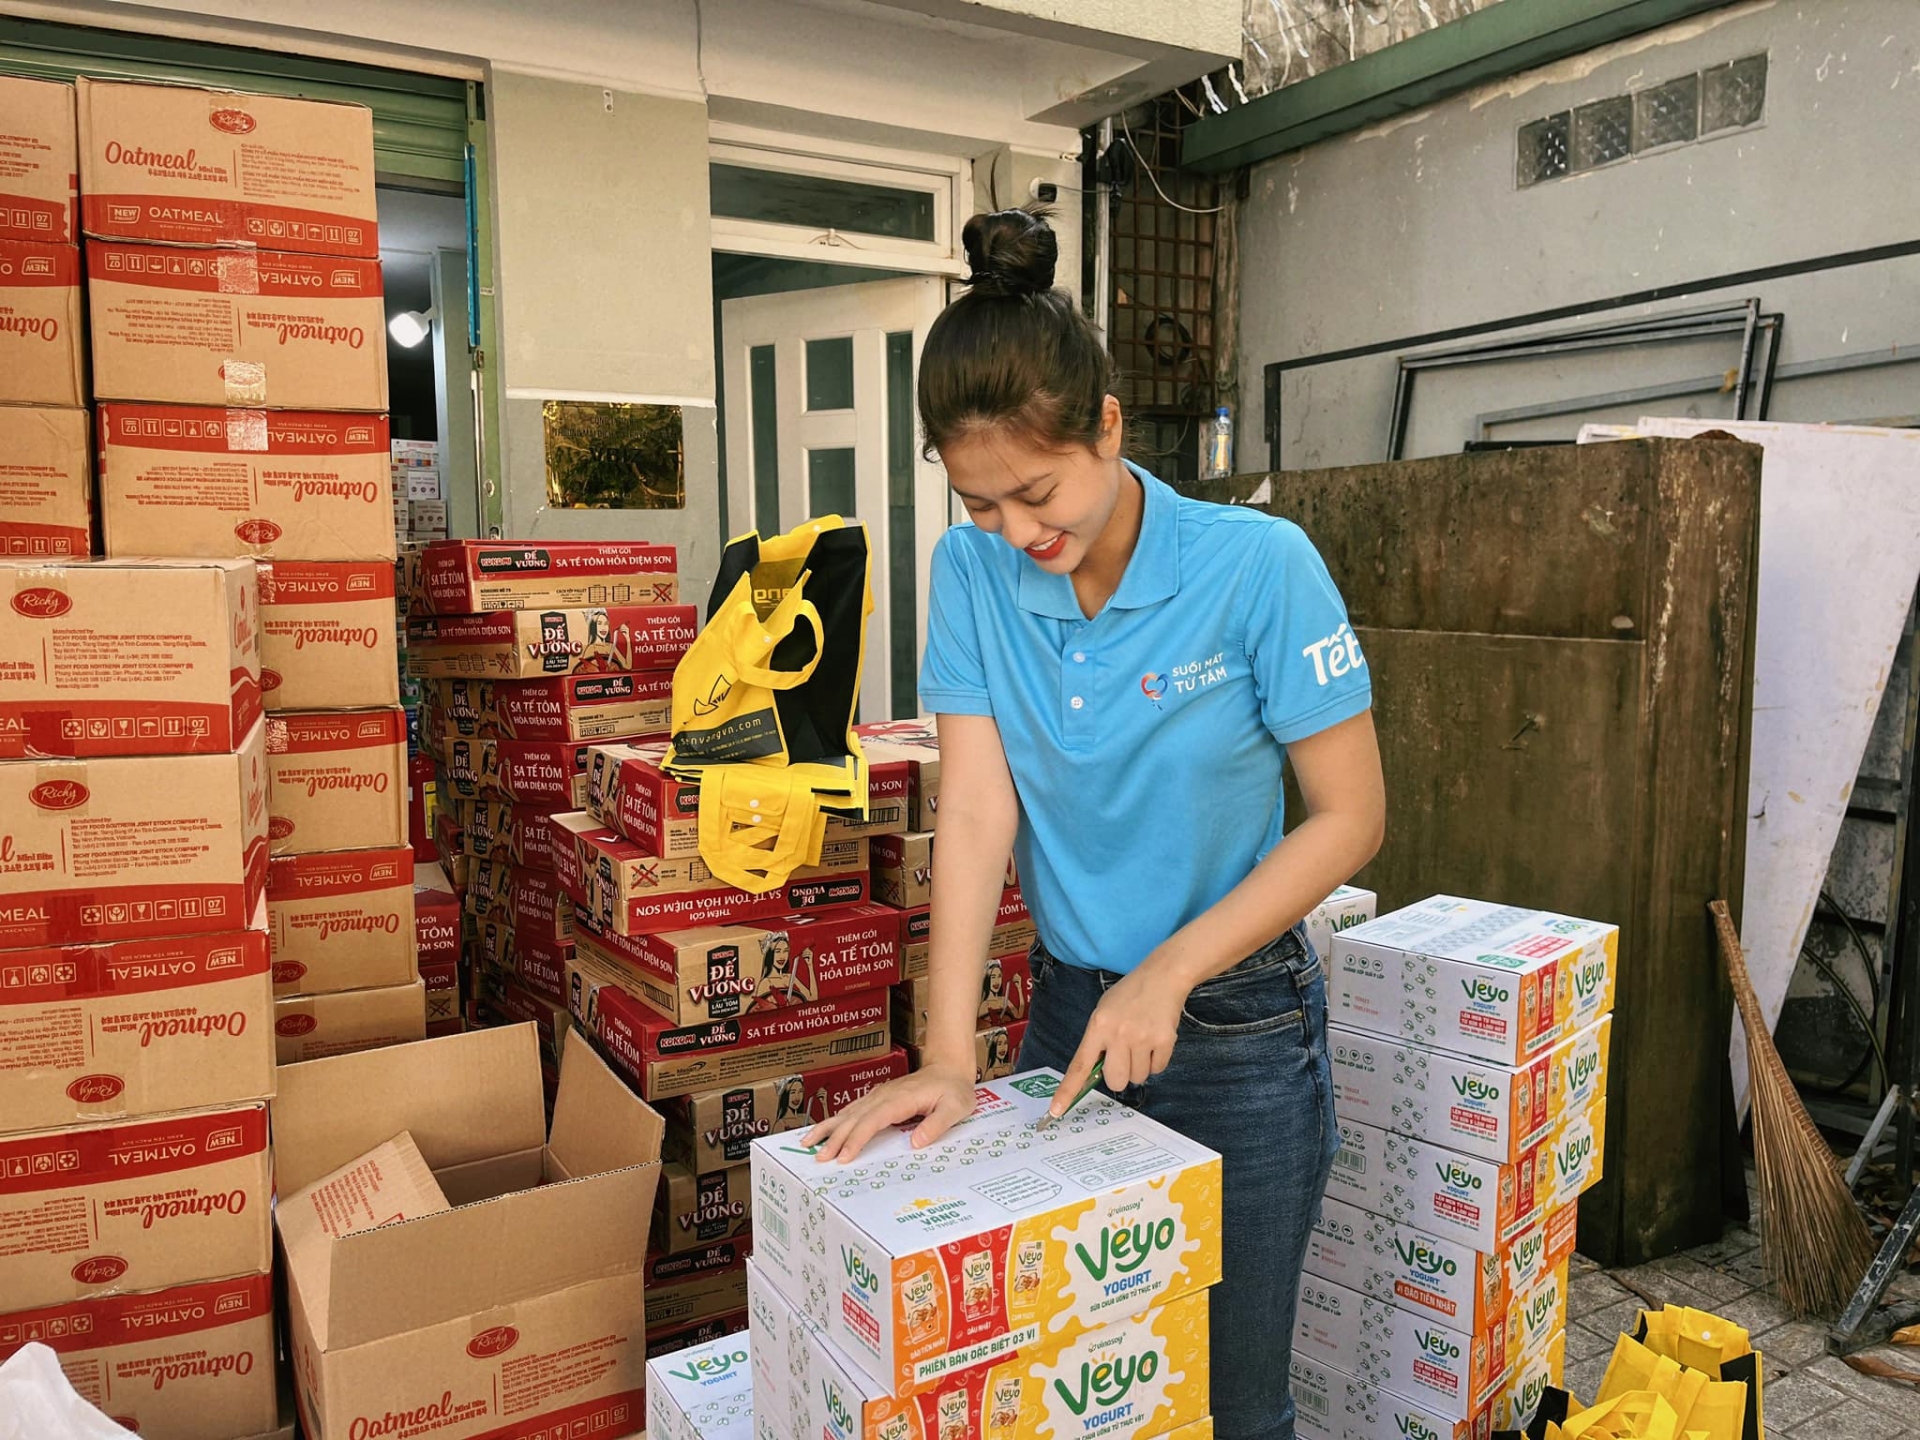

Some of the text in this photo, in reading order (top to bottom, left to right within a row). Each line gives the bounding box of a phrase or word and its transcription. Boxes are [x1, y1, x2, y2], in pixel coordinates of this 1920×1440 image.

[105, 141, 197, 171] Oatmeal
[36, 214, 48, 222] 07
[114, 208, 137, 217] NEW
[149, 206, 224, 224] OATMEAL
[26, 263, 49, 272] NEW
[334, 276, 355, 284] NEW
[277, 323, 364, 349] Oatmeal
[353, 433, 370, 441] NEW
[293, 481, 378, 503] Oatmeal
[481, 556, 548, 569] KOKOMI VƯƠNG
[556, 553, 672, 567] SA TẾ TÔM HỎA DIỆM SƠN
[22, 590, 60, 613] Richy
[646, 615, 681, 625] THÊM GÓI
[294, 627, 378, 650] Oatmeal
[545, 623, 566, 641] ĐẾ
[635, 625, 695, 642] SA TẾ TÔM
[528, 640, 583, 658] VƯƠNG
[635, 643, 677, 654] HỎA DIỆM
[1302, 623, 1360, 686] Tết
[1172, 653, 1224, 677] SUỐI MÁT
[1174, 667, 1228, 694] TỪ TÂM
[454, 690, 467, 706] ĐẾ
[511, 698, 561, 713] SA TẾ TÔM
[447, 706, 479, 719] VƯƠNG
[192, 720, 204, 728] 07
[455, 751, 469, 767] ĐẾ
[447, 768, 478, 782] VƯƠNG
[514, 761, 562, 778] SA TẾ TÔM
[40, 784, 77, 805] Richy
[308, 773, 388, 797] Oatmeal
[298, 873, 363, 888] OATMEAL
[373, 869, 393, 878] NEW
[725, 894, 751, 906] TÔM
[768, 890, 782, 901] SA
[792, 885, 860, 897] KOKOMI VƯƠNG
[208, 899, 220, 908] 07
[636, 904, 661, 917] SƠN
[663, 901, 694, 914] DIỆM
[697, 897, 722, 910] HỎA
[689, 909, 731, 922] THÊM GÓI
[320, 912, 399, 940] Oatmeal
[420, 927, 454, 939] TÔM
[434, 940, 455, 951] SƠN
[836, 929, 878, 944] THÊM GÓI
[210, 956, 236, 966] NEW
[819, 942, 893, 967] SA TẾ TÔM
[106, 961, 196, 981] OATMEAL
[710, 956, 737, 980] ĐẾ
[819, 957, 894, 982] HỎA DIỆM SƠN
[690, 976, 755, 1002] VƯƠNG
[1576, 962, 1604, 998] Veyo
[1461, 979, 1509, 1003] Veyo
[797, 1004, 836, 1017] THÊM GÓI
[139, 1011, 247, 1048] Oatmeal
[712, 1021, 726, 1034] ĐẾ
[747, 1006, 882, 1039] SA TẾ TÔM HỎA DIỆM SƠN
[660, 1032, 736, 1048] KOKOMI VƯƠNG
[79, 1078, 117, 1102] Richy
[1450, 1073, 1499, 1100] Veyo
[725, 1100, 752, 1124] ĐẾ
[209, 1135, 236, 1148] NEW
[706, 1118, 770, 1147] VƯƠNG
[107, 1143, 196, 1166] OATMEAL
[1557, 1135, 1591, 1176] Veyo
[1435, 1161, 1482, 1190] Veyo
[700, 1182, 725, 1206] ĐẾ
[140, 1189, 247, 1229] Oatmeal
[679, 1200, 744, 1231] VƯƠNG
[1115, 1200, 1141, 1215] vinasoy
[1018, 1251, 1043, 1266] Veyo
[1075, 1217, 1175, 1281] Veyo
[1394, 1238, 1457, 1277] Veyo
[84, 1260, 120, 1283] Richy
[841, 1244, 879, 1294] Veyo
[1409, 1268, 1440, 1285] YOGURT
[1103, 1269, 1152, 1297] YOGURT
[218, 1298, 243, 1310] NEW
[1525, 1290, 1556, 1331] Veyo
[121, 1306, 206, 1329] OATMEAL
[475, 1333, 509, 1350] Richy
[1414, 1329, 1460, 1358] Veyo
[919, 1328, 1036, 1378] PHIÊN BẢN ĐẶC BIỆT 03 VỊ
[153, 1351, 254, 1390] Oatmeal
[668, 1349, 748, 1382] Veyo
[700, 1370, 739, 1387] YOGURT
[1054, 1350, 1159, 1416] Veyo
[350, 1391, 454, 1440] Oatmeal
[1083, 1403, 1134, 1430] YOGURT
